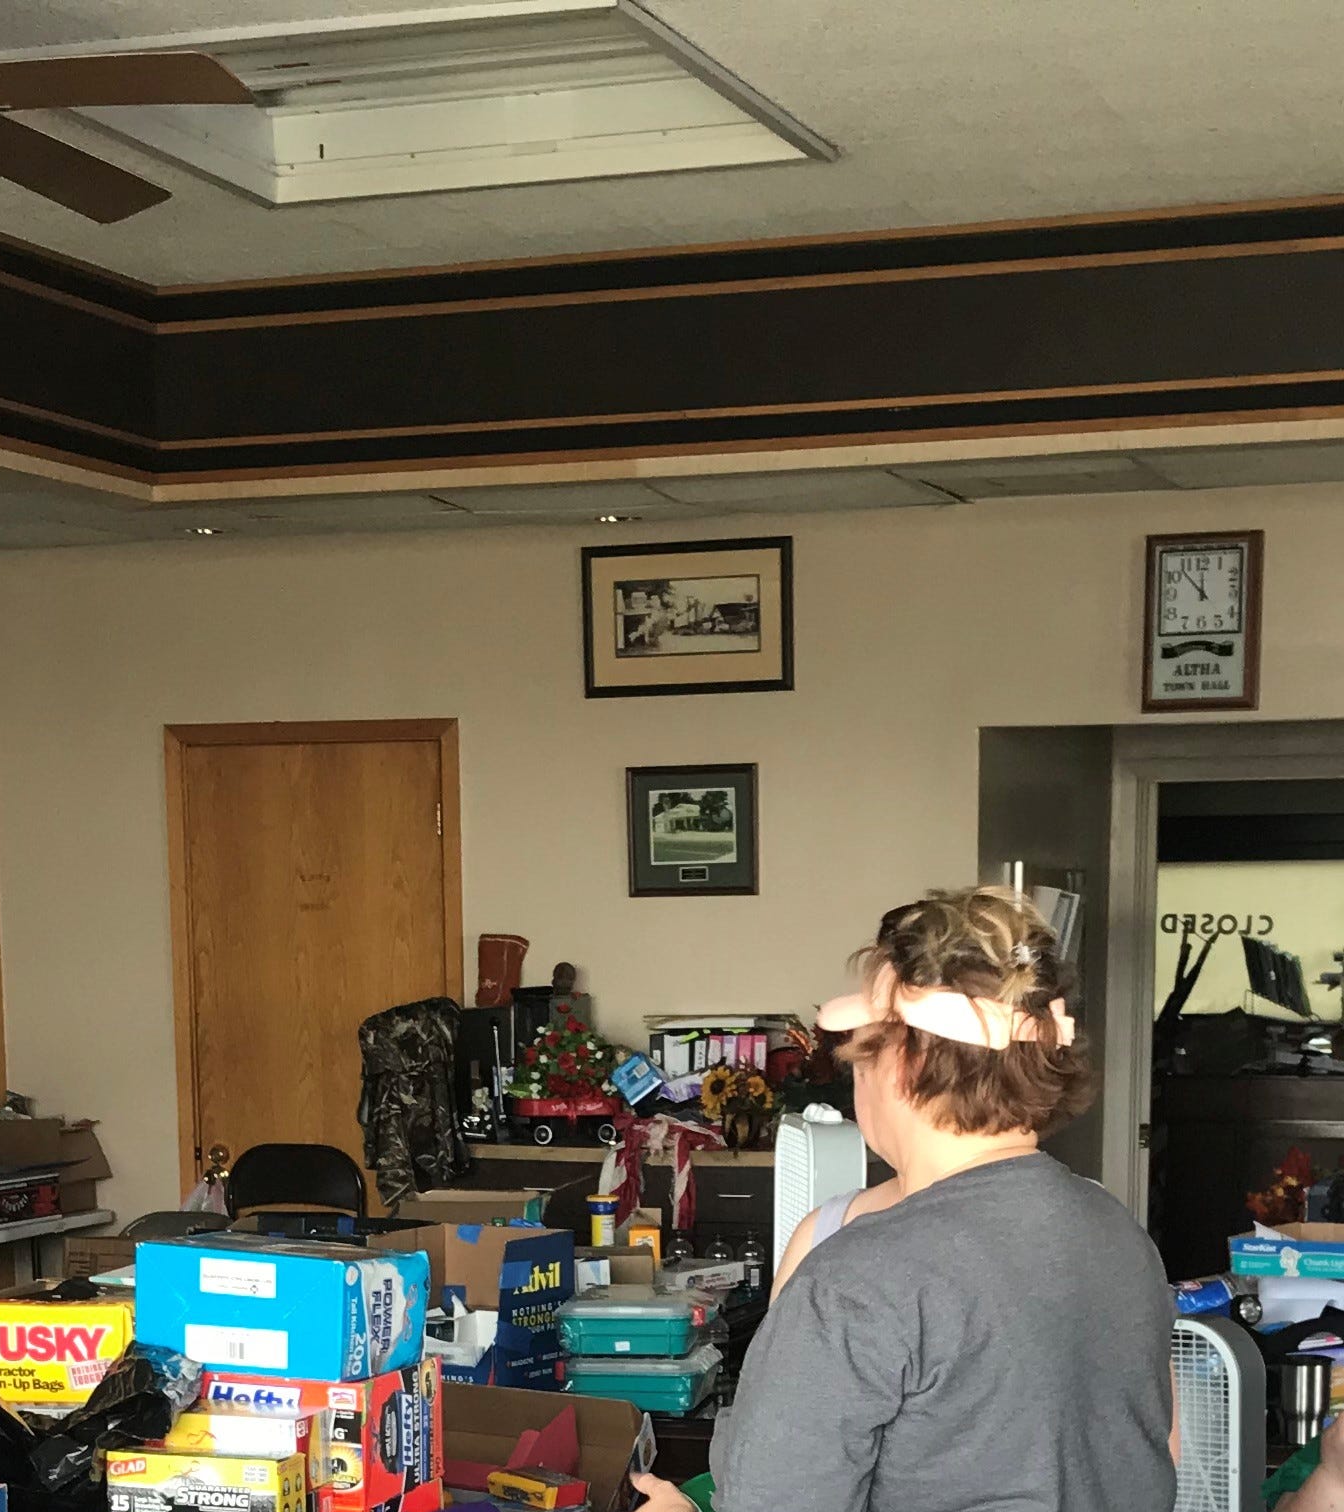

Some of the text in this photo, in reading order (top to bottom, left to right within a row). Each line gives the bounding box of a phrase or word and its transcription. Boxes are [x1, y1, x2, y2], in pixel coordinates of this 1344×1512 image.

[1173, 663, 1221, 676] ALTHA
[1163, 680, 1231, 692] TOWN HALL
[371, 1291, 381, 1343] FLEX
[381, 1279, 392, 1351] POWER
[352, 1333, 366, 1375] 200
[33, 1379, 65, 1392] Bags
[404, 1397, 413, 1462] Hefty
[110, 1460, 145, 1476] GLAD
[176, 1487, 248, 1507] STRONG
[189, 1485, 251, 1493] GUARANTEED
[111, 1495, 129, 1512] 15
